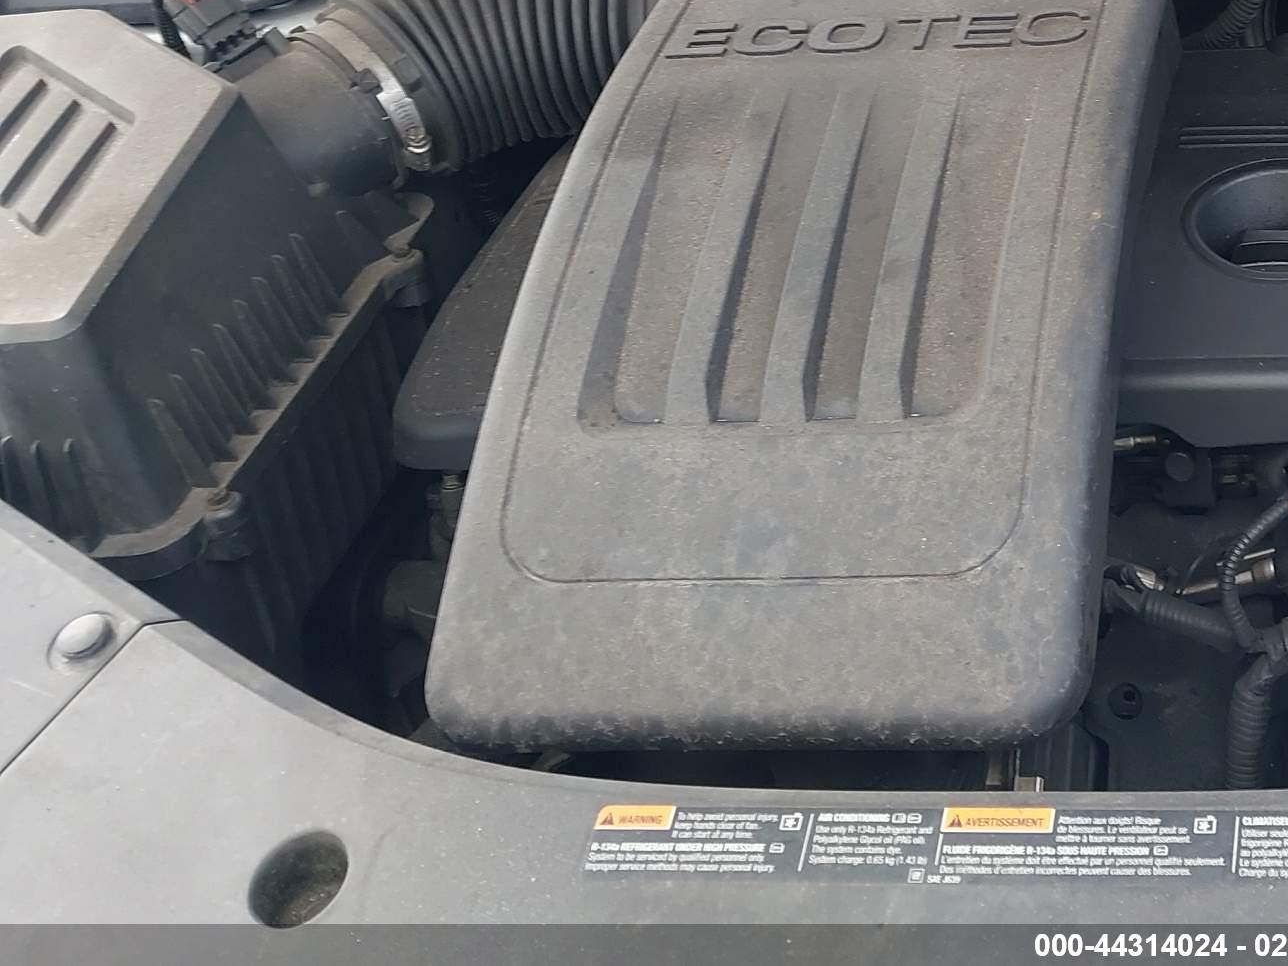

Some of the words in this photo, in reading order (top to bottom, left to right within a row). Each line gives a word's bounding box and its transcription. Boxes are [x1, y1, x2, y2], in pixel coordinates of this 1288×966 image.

[663, 10, 1092, 58] ECOTEC
[619, 816, 663, 824] WARNING
[818, 813, 833, 822] AIR
[834, 813, 890, 822] CONDITIONING
[1058, 816, 1092, 825] Attention
[1135, 817, 1161, 826] Risque
[966, 818, 1044, 827] AVERTISSEMENT
[816, 825, 830, 834] Use
[831, 826, 846, 834] only
[848, 826, 875, 834] R-134a
[876, 826, 917, 835] Refrigerant
[918, 826, 933, 834] and
[1107, 826, 1117, 834] Le
[1119, 826, 1158, 834] ventilateur
[1159, 827, 1176, 835] peut
[1241, 829, 1268, 838] Utiliser
[860, 835, 882, 844] Glycol
[883, 836, 893, 844] oil
[620, 842, 674, 851] REFRIGERANT
[675, 843, 703, 851] UNDER
[703, 843, 723, 851] HIGH
[724, 843, 766, 852] PRESSURE
[812, 844, 825, 853] The
[827, 846, 853, 855] system
[855, 846, 885, 854] contains
[942, 845, 971, 854] FLUIDE
[1026, 846, 1055, 855] R-134a
[1057, 846, 1079, 855] SOUS
[1080, 846, 1107, 855] HAUTE
[1108, 846, 1150, 855] PRESSION
[588, 853, 616, 862] System
[711, 854, 747, 862] personnel
[808, 855, 836, 865] System
[885, 856, 895, 866] kg
[981, 856, 992, 864] du
[993, 856, 1025, 866] système
[1026, 856, 1040, 864] doit
[1090, 858, 1103, 866] par
[1116, 858, 1153, 866] personnel
[584, 863, 618, 872] Improper
[680, 864, 696, 872] may
[696, 864, 719, 872] cause
[720, 864, 752, 872] personal
[1239, 859, 1249, 867] Le
[1251, 859, 1283, 868] système
[939, 865, 954, 874] Des
[955, 865, 992, 874] méthodes
[1078, 867, 1109, 876] peuvent
[1110, 867, 1136, 875] causer
[1239, 869, 1266, 878] Charge
[1268, 869, 1279, 877] du
[927, 875, 942, 883] SAE
